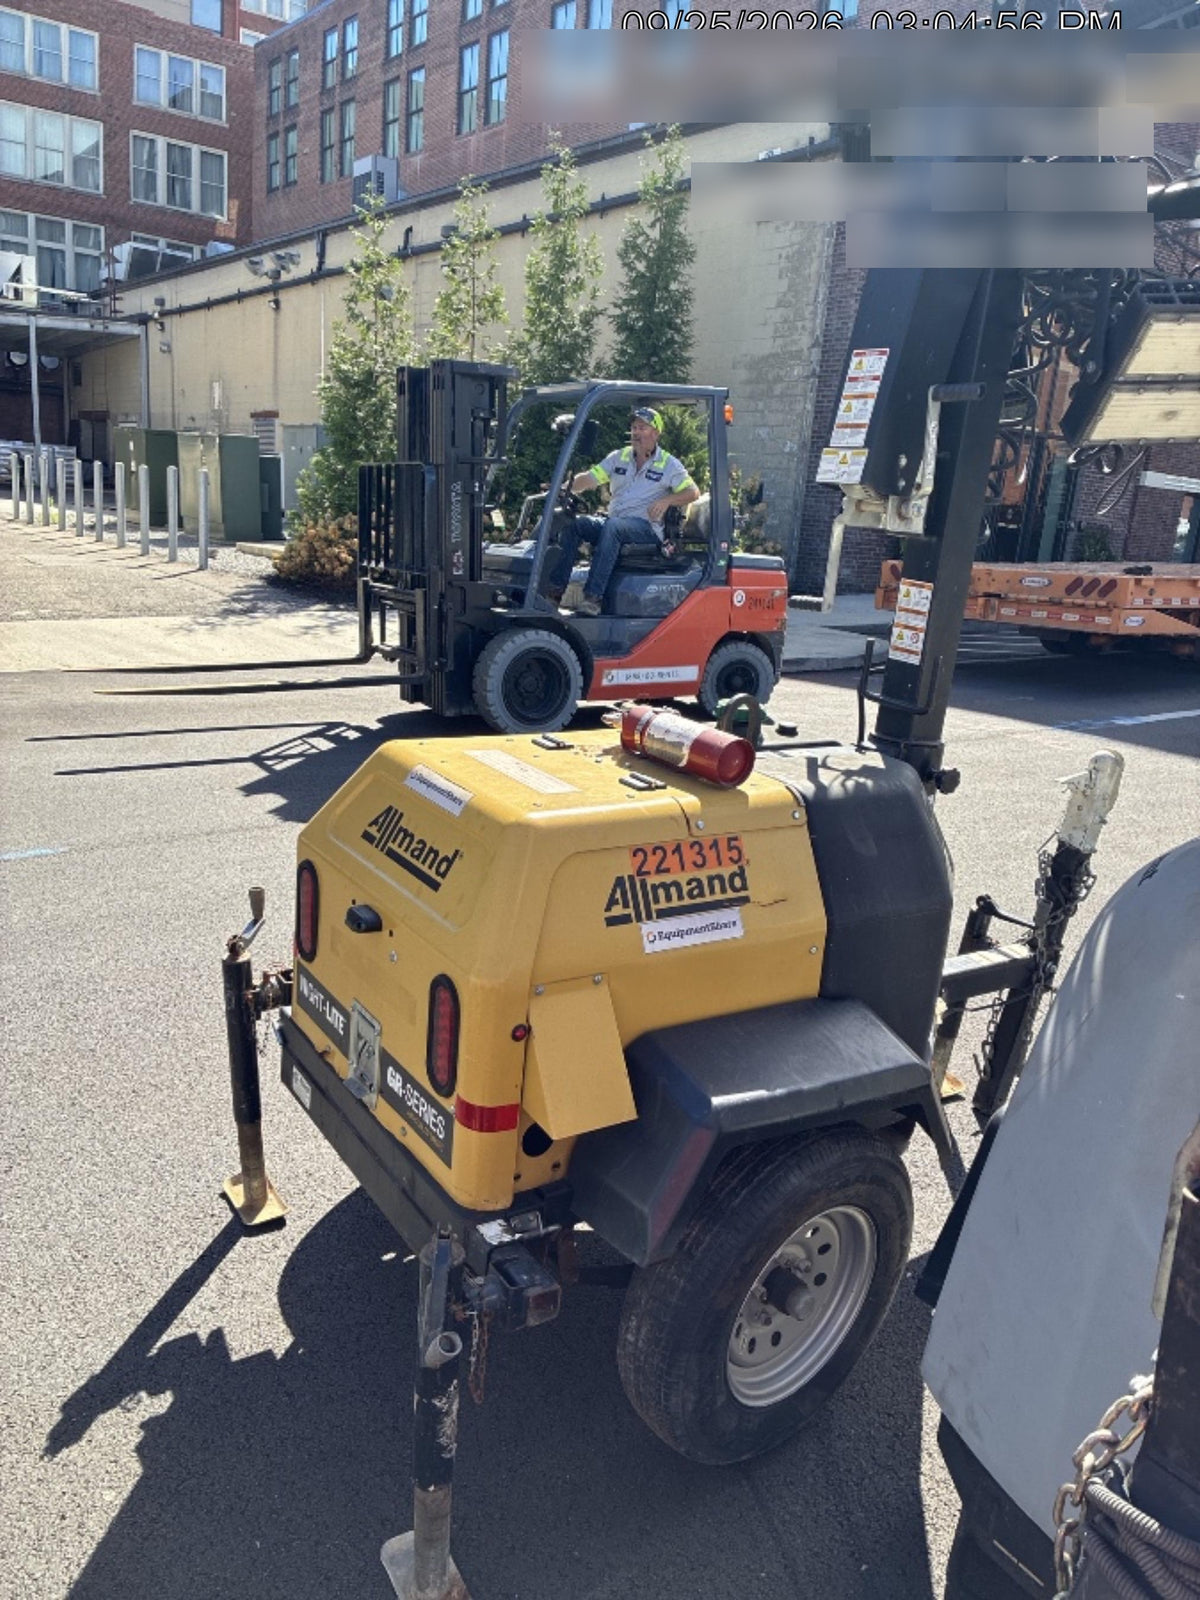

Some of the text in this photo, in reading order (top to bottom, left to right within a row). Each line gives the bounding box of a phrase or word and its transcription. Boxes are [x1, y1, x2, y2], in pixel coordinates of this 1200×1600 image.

[367, 804, 461, 880] Allmand
[632, 836, 743, 877] 221315
[604, 866, 749, 923] Allmand
[386, 1065, 446, 1140] GR-SERIES
